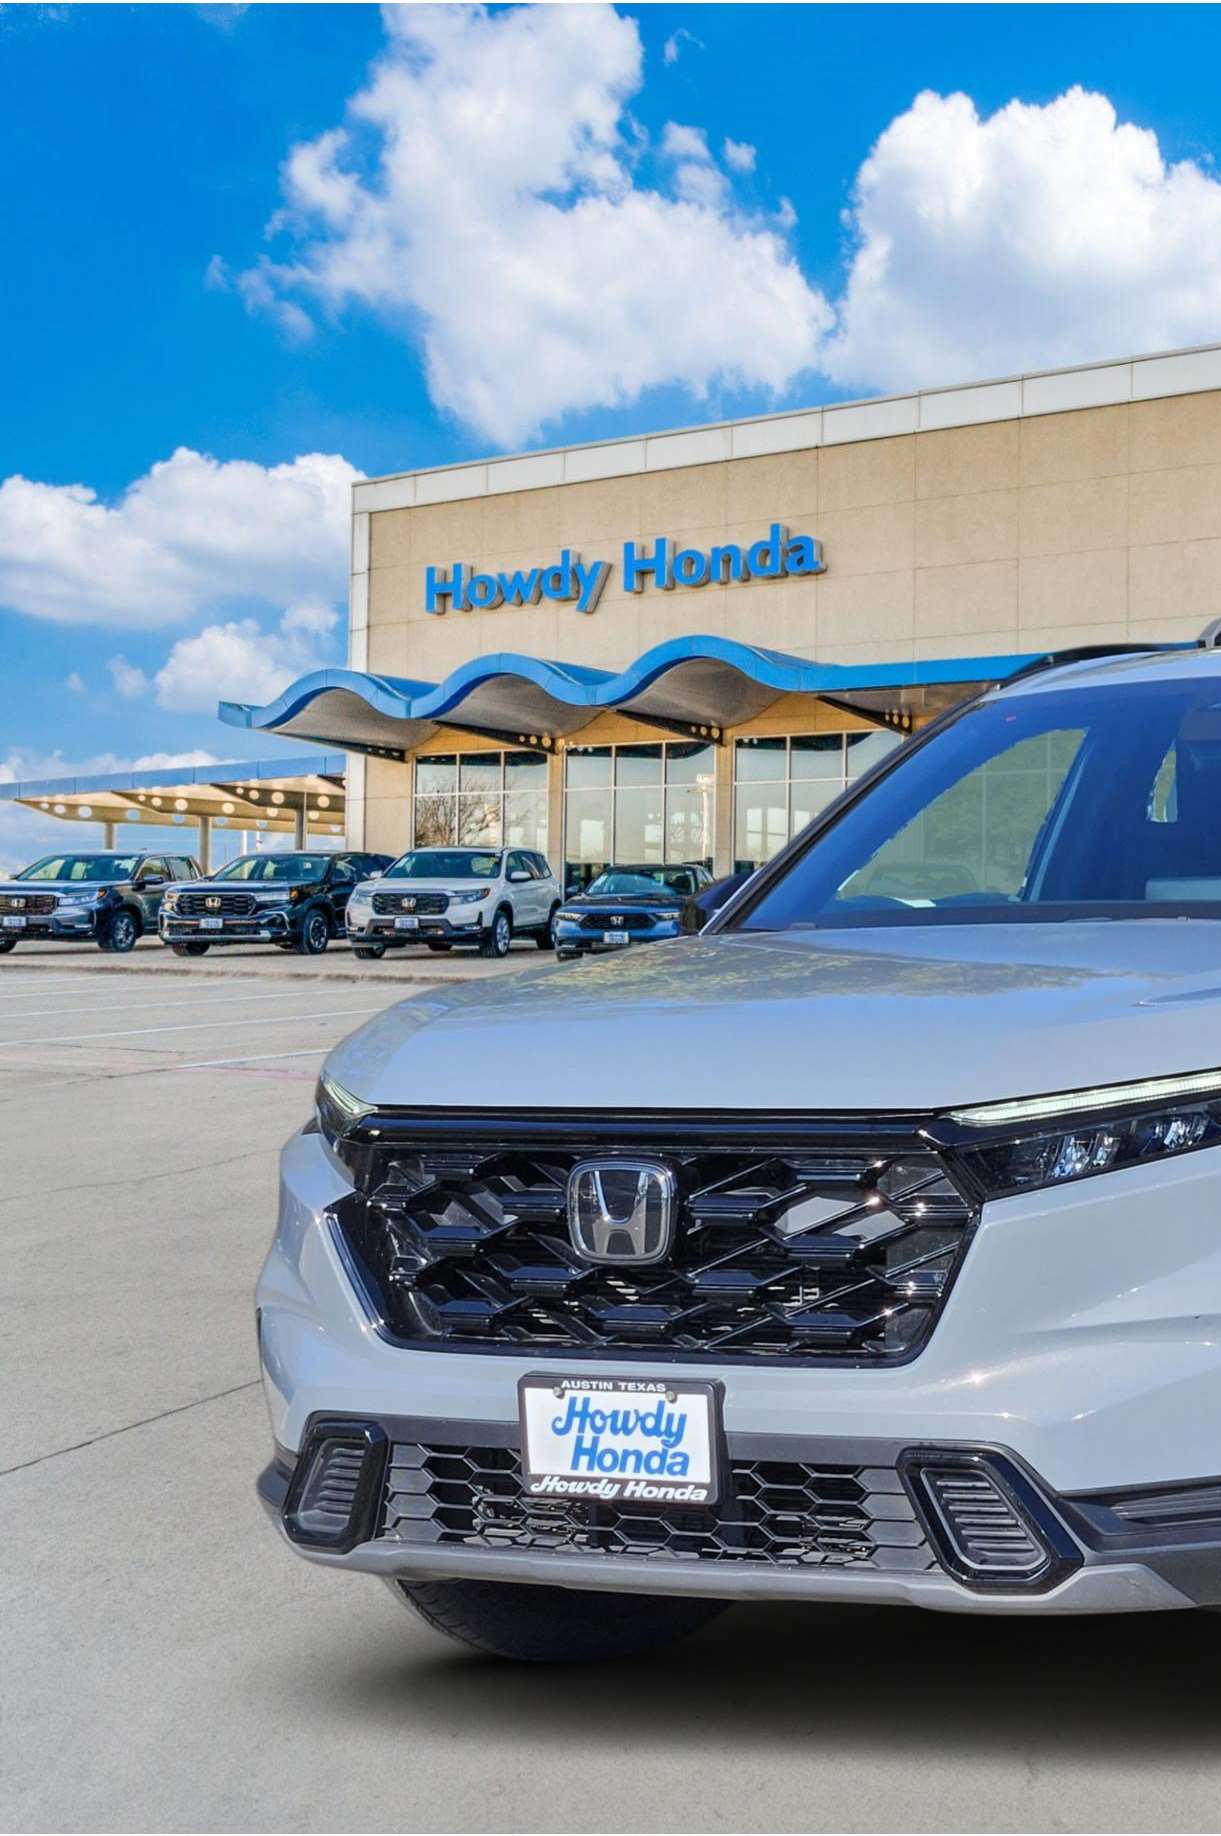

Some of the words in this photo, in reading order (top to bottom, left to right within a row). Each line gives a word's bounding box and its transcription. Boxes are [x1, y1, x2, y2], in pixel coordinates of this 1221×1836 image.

[425, 548, 612, 614] Howdy
[623, 523, 827, 593] Honda
[561, 1380, 613, 1390] AUSTIN
[618, 1382, 667, 1392] TEXAS
[552, 1396, 687, 1448] Howdy
[570, 1435, 690, 1476] Honda
[530, 1476, 621, 1499] Howdy
[623, 1481, 708, 1501] Honda
